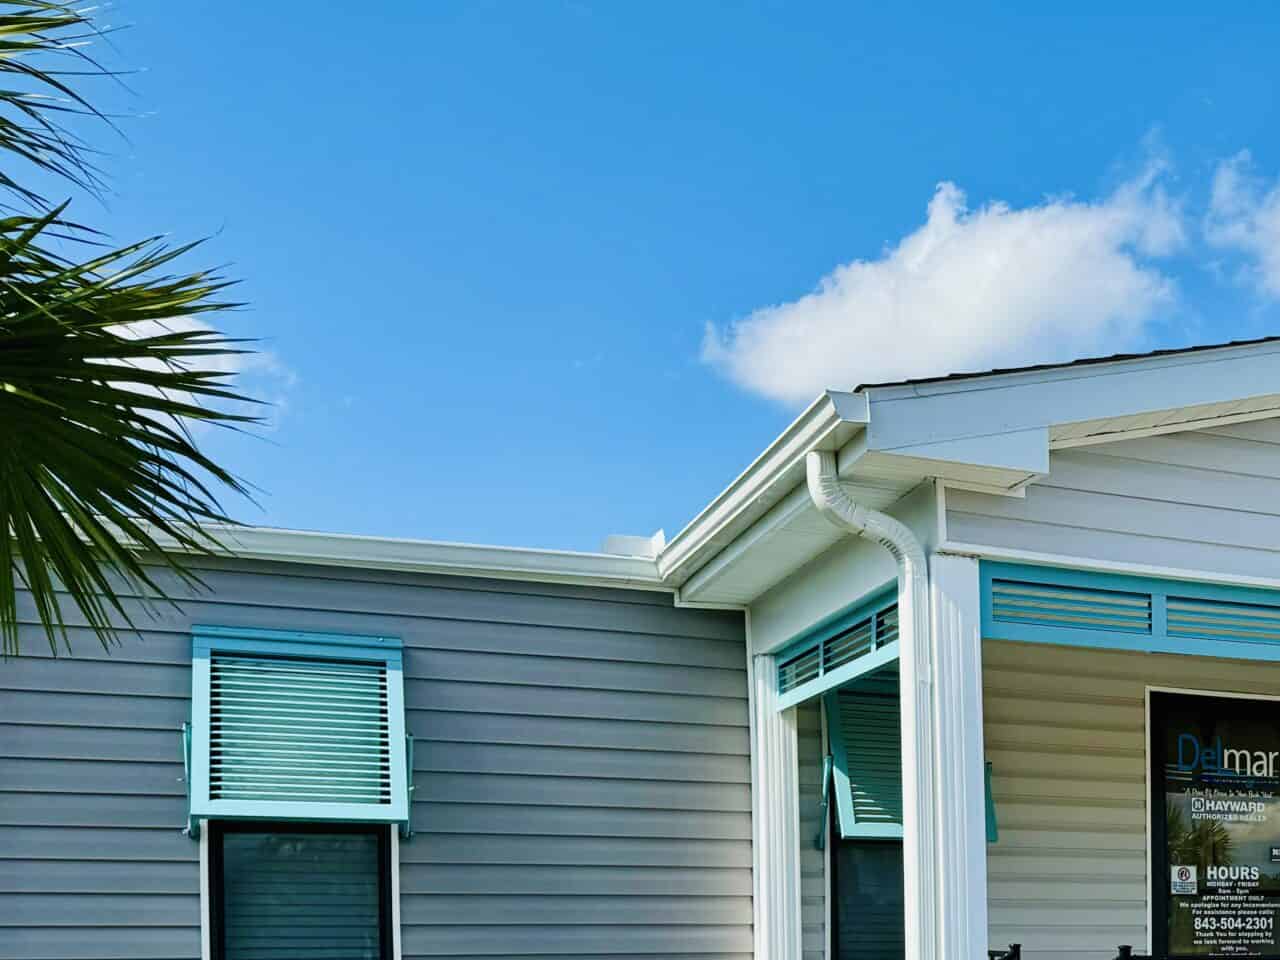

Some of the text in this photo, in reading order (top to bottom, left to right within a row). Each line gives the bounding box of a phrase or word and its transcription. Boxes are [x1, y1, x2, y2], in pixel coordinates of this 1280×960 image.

[1177, 733, 1279, 777] Delmar
[1206, 800, 1265, 812] HAYWARD
[1207, 866, 1260, 880] HOURS
[1194, 917, 1273, 930] 843-504-2301
